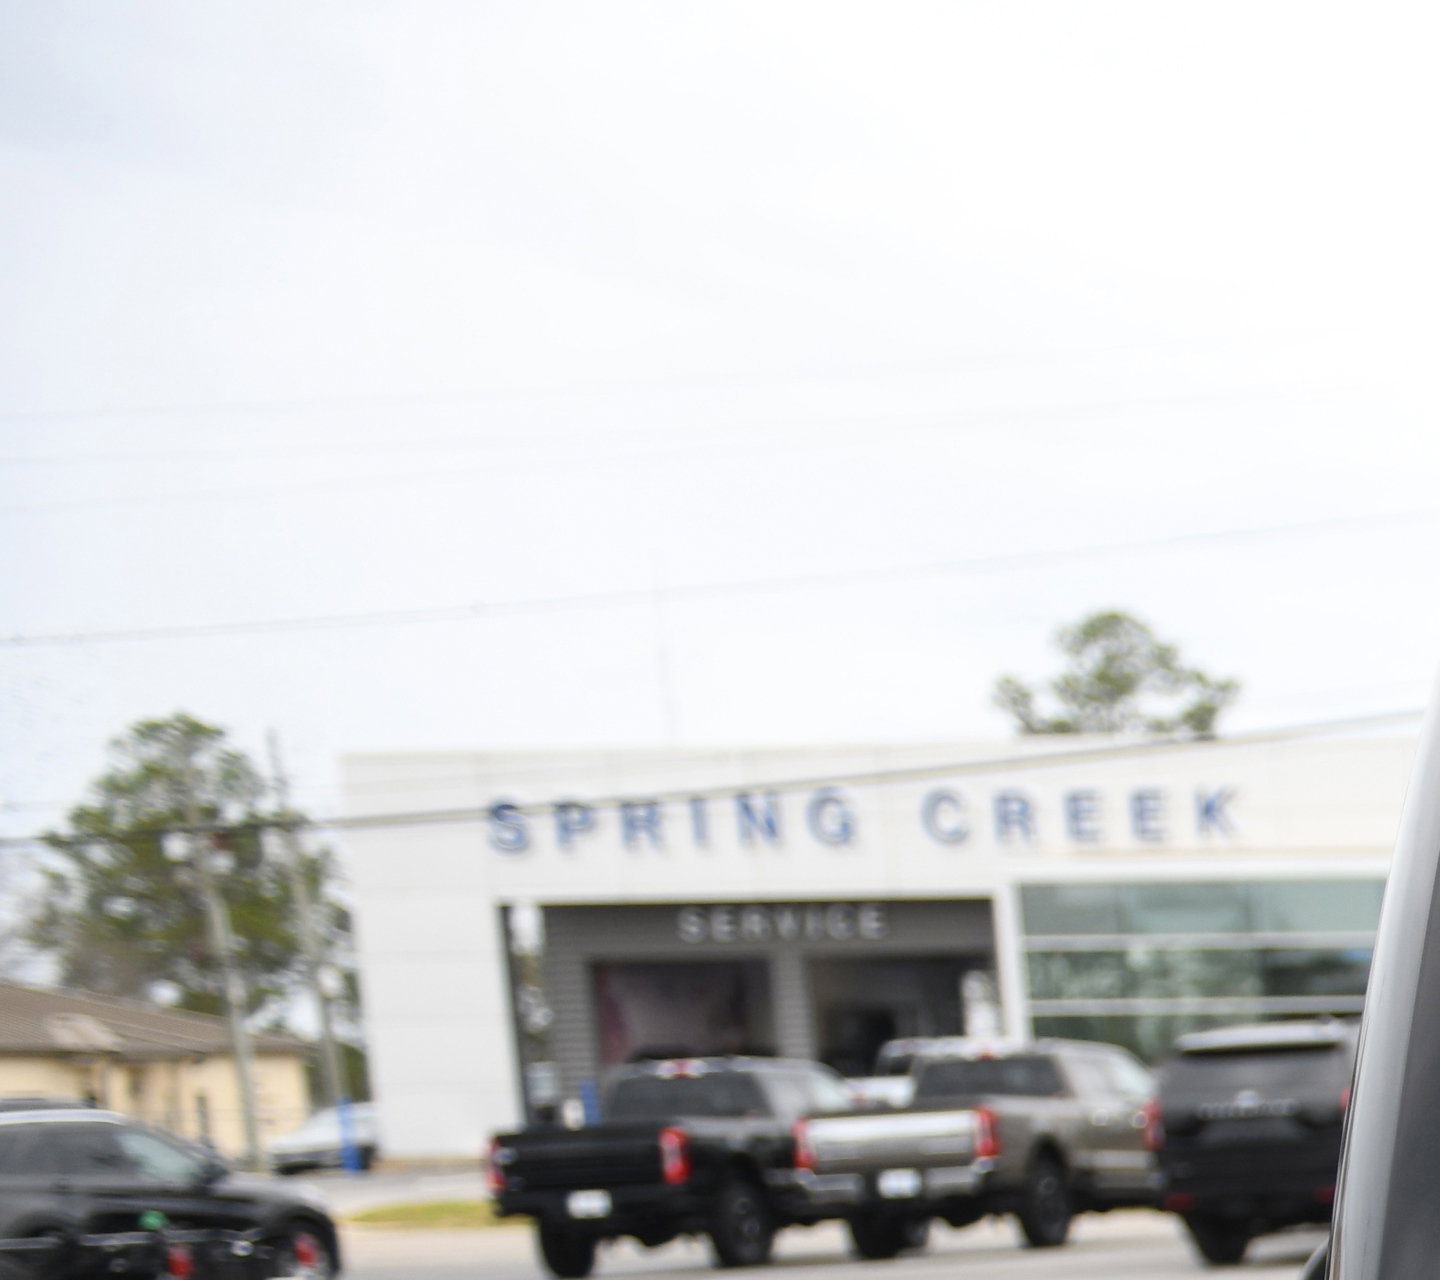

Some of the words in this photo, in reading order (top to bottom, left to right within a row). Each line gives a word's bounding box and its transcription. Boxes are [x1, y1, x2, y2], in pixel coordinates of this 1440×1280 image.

[488, 787, 855, 854] SPRING
[922, 785, 1238, 844] CREEK
[677, 902, 889, 944] SERVICE
